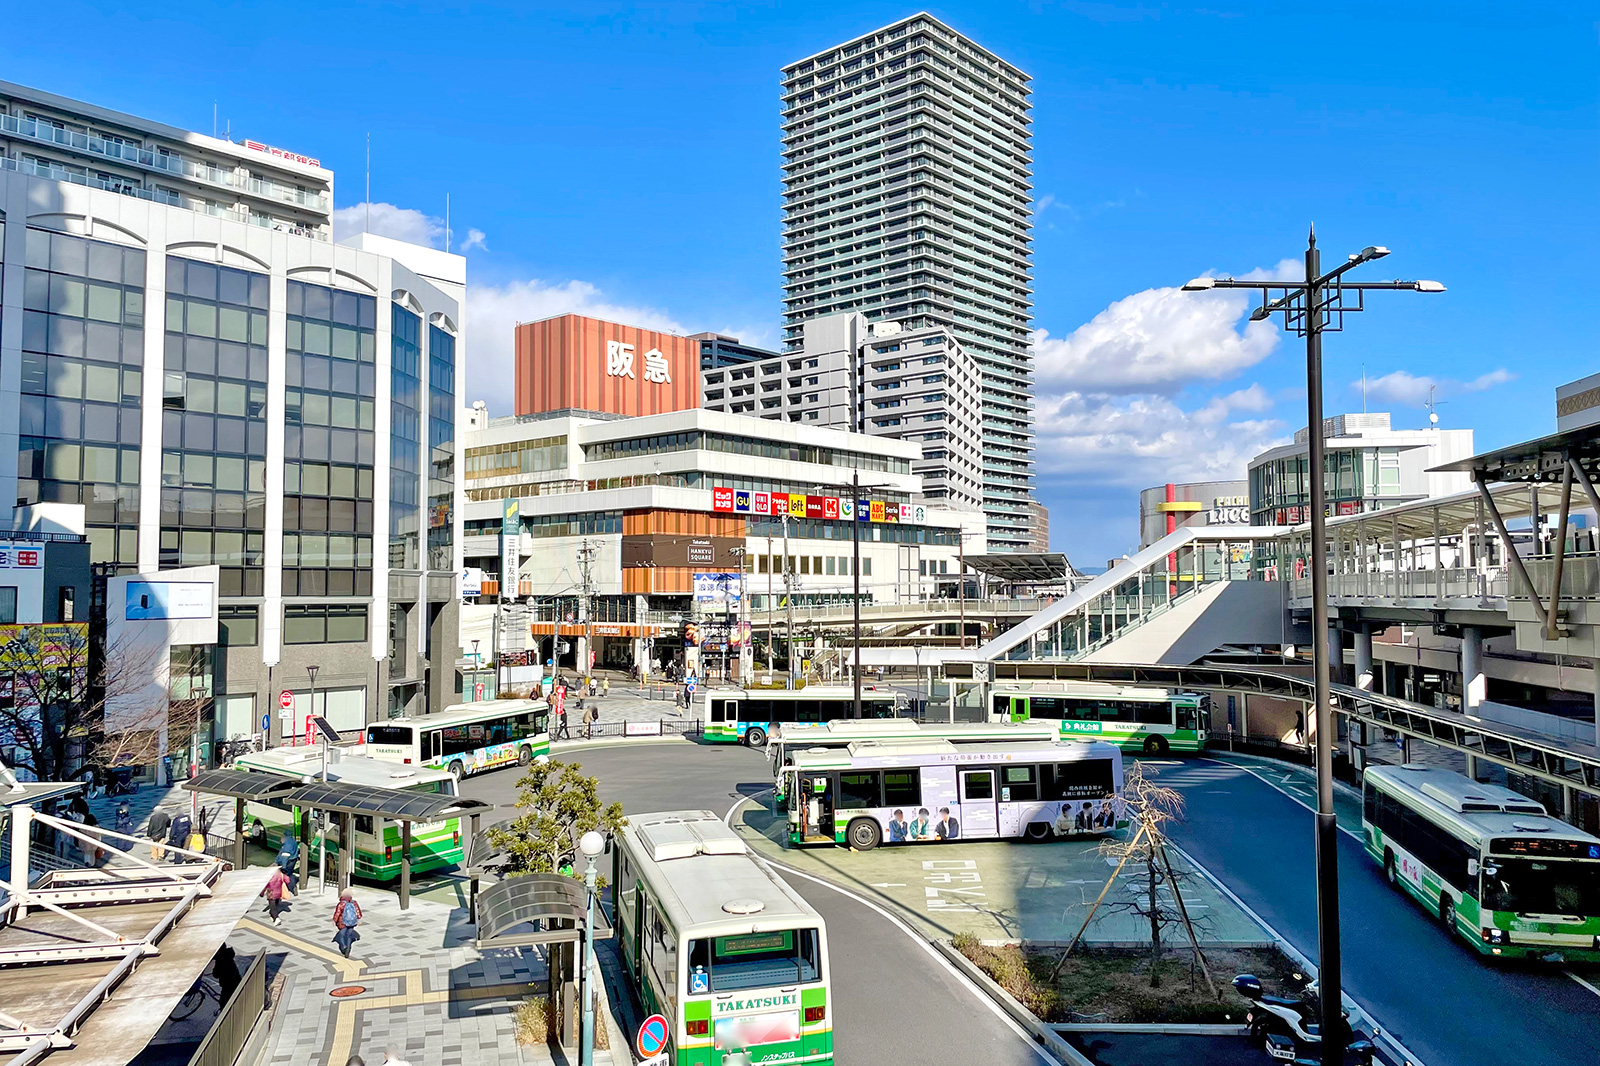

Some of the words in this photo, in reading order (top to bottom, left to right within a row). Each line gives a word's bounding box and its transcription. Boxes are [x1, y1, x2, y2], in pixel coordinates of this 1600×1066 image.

[607, 339, 672, 384] 阪急
[736, 496, 749, 507] GU
[756, 503, 768, 512] QLO
[872, 503, 884, 513] ABC
[886, 506, 898, 514] Seria
[507, 538, 516, 594] 三井住友銀行
[717, 994, 797, 1012] TAKATSUKI
[760, 1051, 796, 1062] ノンステップバス
